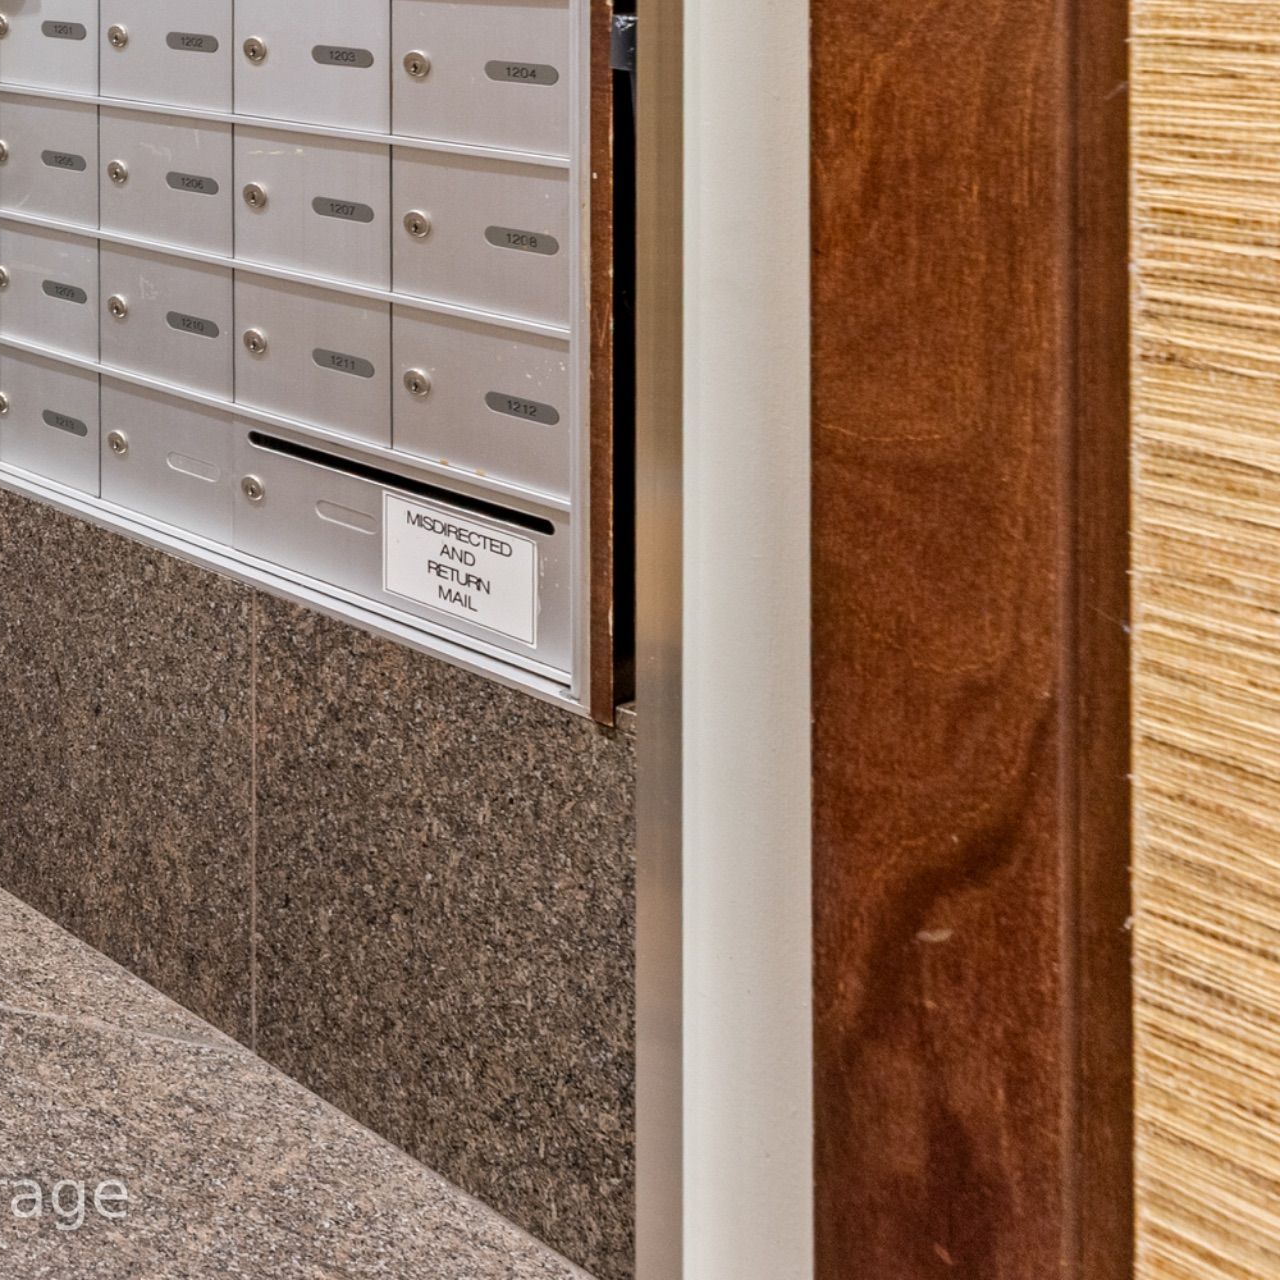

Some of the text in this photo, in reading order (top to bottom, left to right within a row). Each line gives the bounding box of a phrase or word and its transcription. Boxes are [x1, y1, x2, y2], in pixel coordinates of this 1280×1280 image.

[54, 25, 72, 34] 1201
[181, 37, 203, 47] 1202
[330, 51, 355, 62] 1203
[506, 67, 536, 79] 1204
[55, 156, 73, 166] 1205
[182, 178, 203, 189] 1206
[330, 203, 355, 215] 1207
[507, 233, 537, 248] 1208
[56, 286, 74, 297] 1209
[182, 319, 203, 331] 1210
[331, 356, 355, 370] 1211
[507, 400, 537, 416] 1212
[56, 417, 74, 429] 1213
[406, 508, 514, 559] MISDIRECTED
[440, 543, 477, 566] AND
[427, 559, 492, 596] RETURN
[438, 584, 479, 612] MAIL
